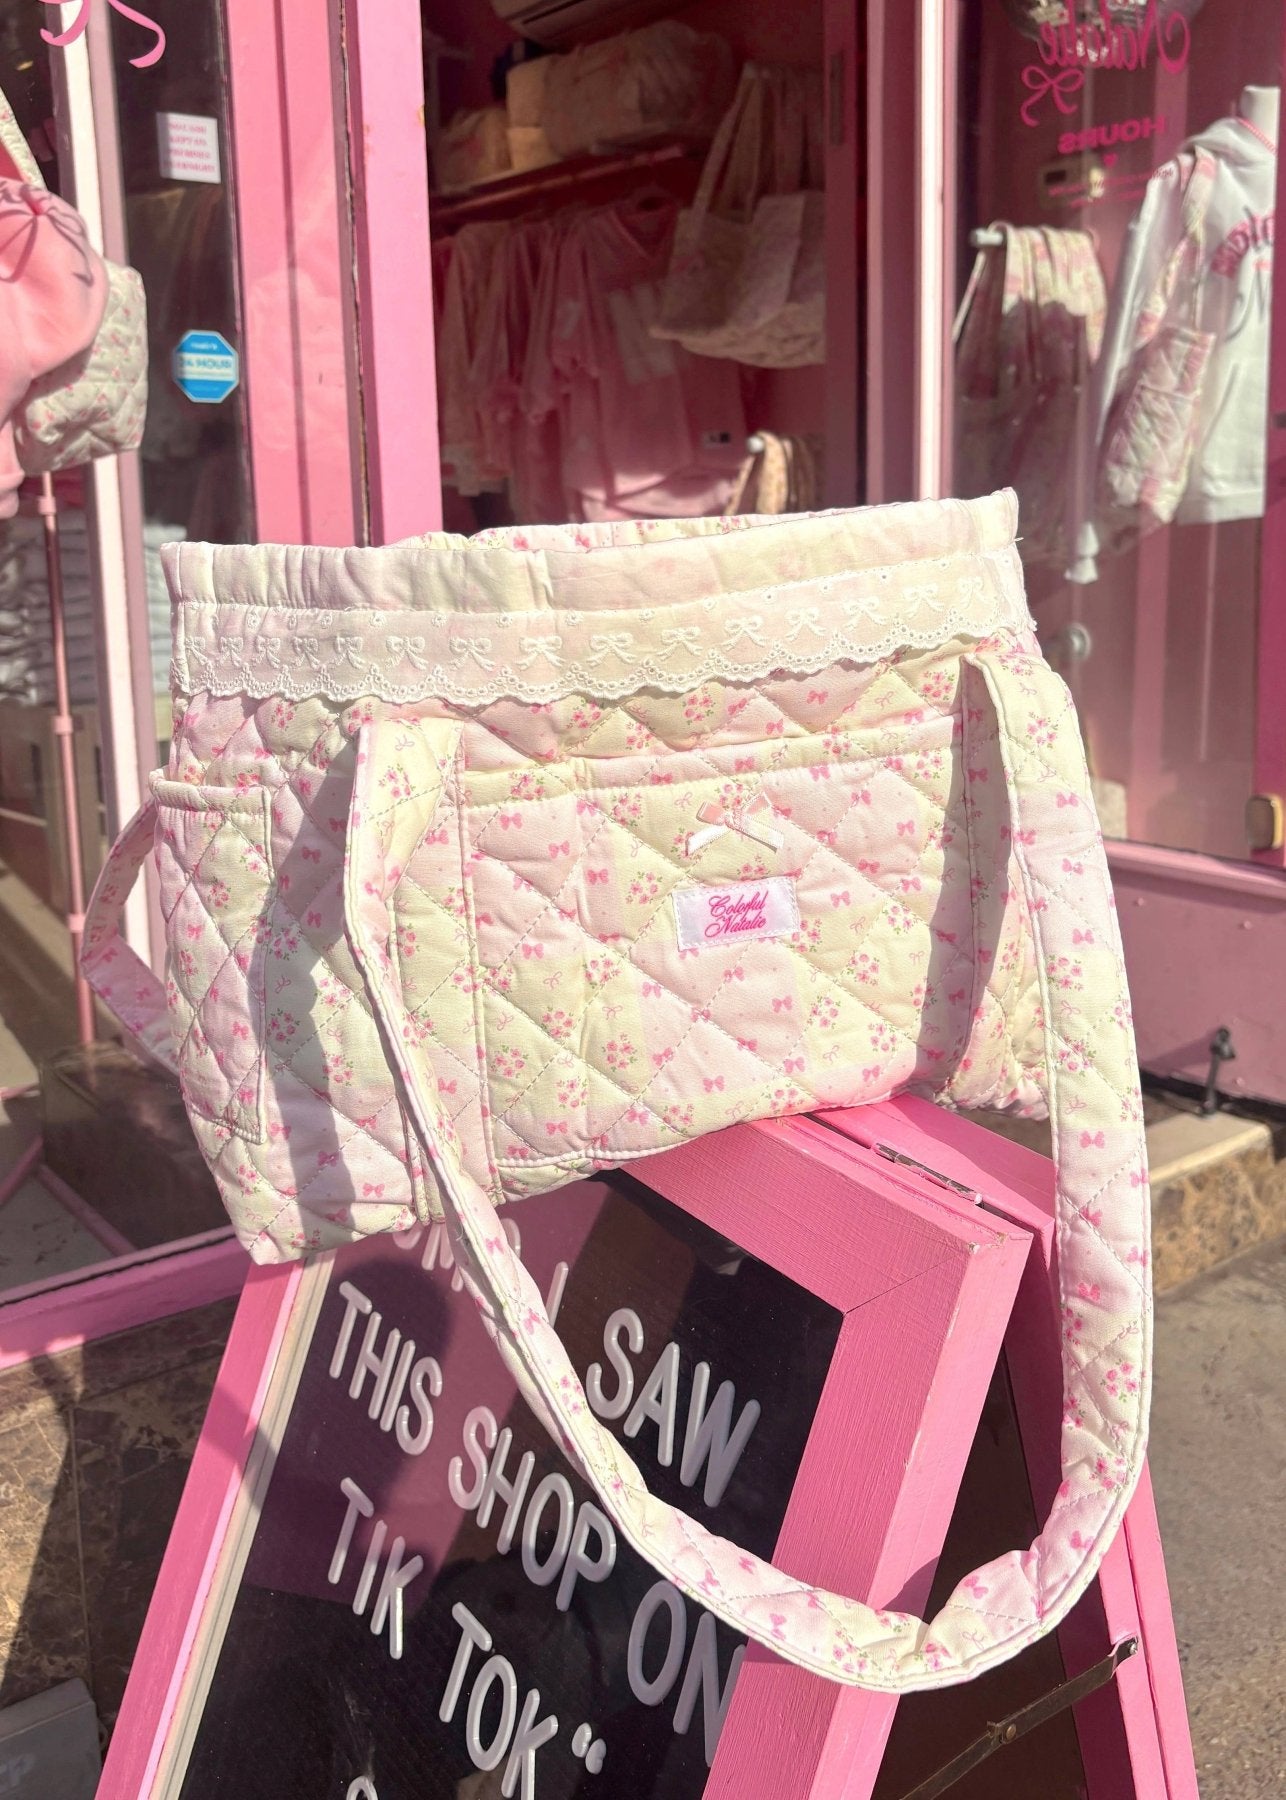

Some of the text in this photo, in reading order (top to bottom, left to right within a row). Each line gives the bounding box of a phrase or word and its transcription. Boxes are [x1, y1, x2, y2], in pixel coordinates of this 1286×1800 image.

[704, 911, 767, 938] Natalie
[708, 890, 769, 918] Colorful
[586, 1307, 761, 1507] SAW
[328, 1280, 442, 1455] THIS
[448, 1405, 616, 1611] SHOP
[627, 1579, 745, 1768] ON
[328, 1477, 423, 1660] TIK
